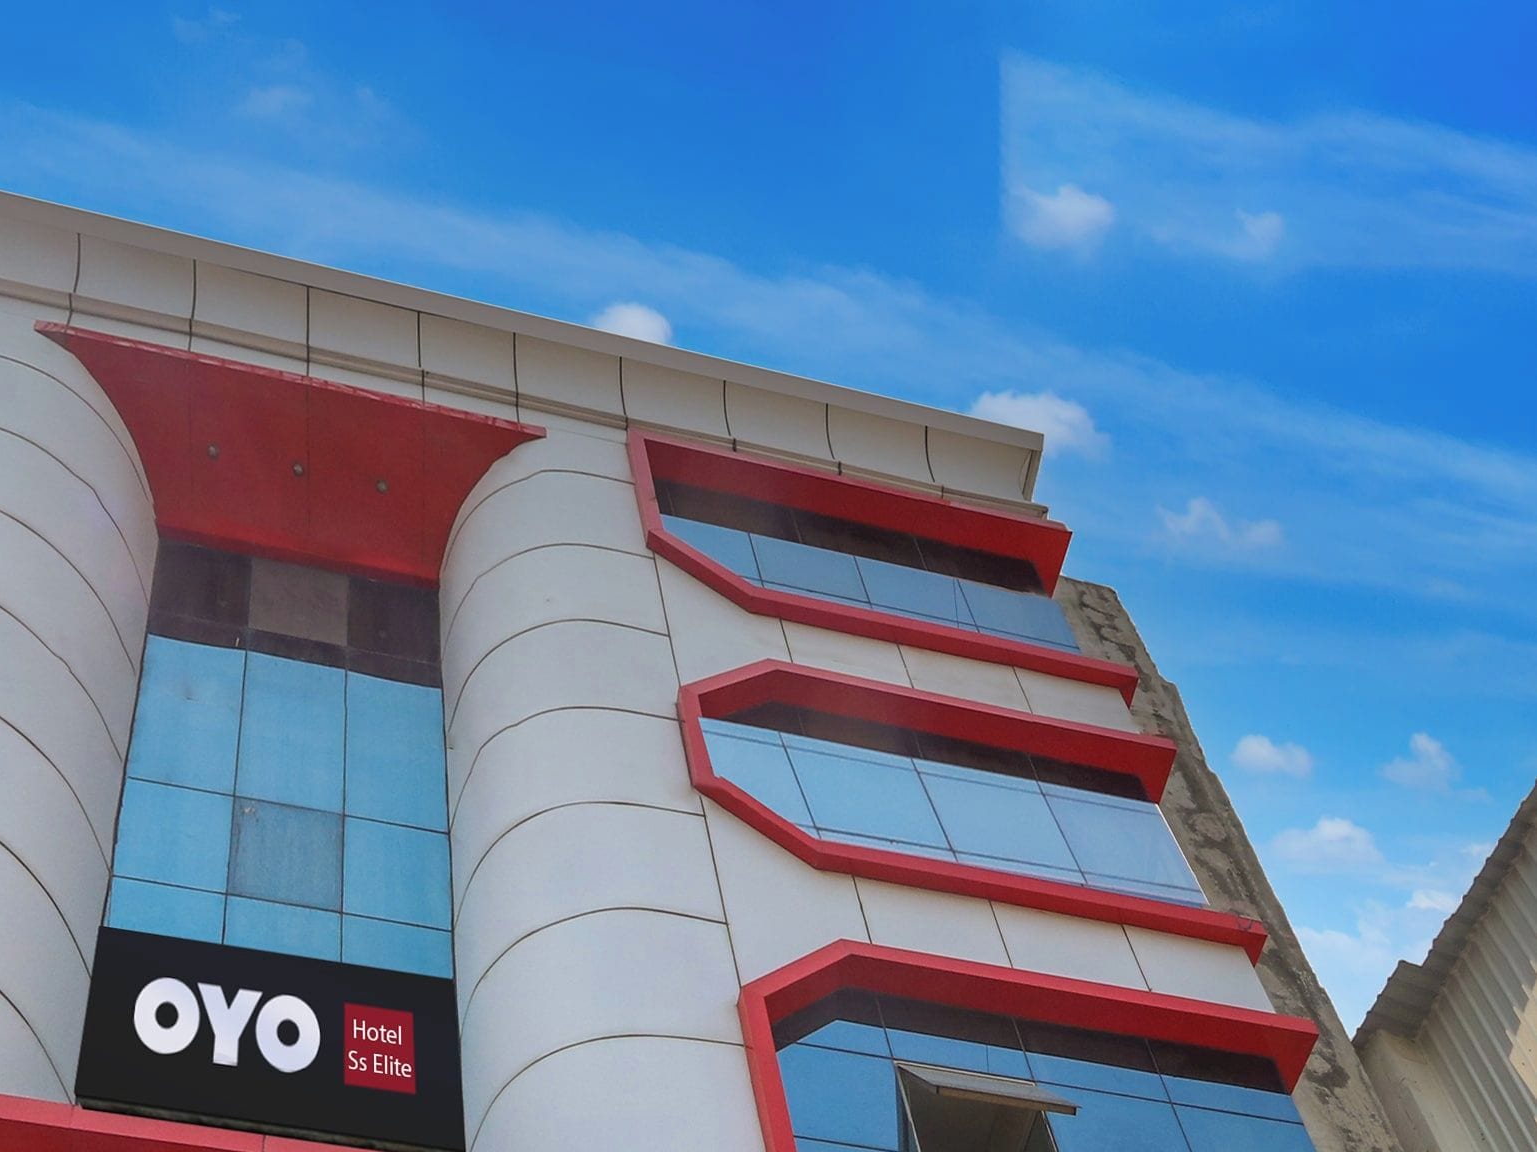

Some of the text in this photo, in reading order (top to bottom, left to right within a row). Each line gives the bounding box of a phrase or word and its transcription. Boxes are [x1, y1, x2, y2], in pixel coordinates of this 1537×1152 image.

[134, 977, 320, 1073] OYO
[353, 1018, 402, 1046] Hotel
[348, 1050, 412, 1079] Ss Elite
